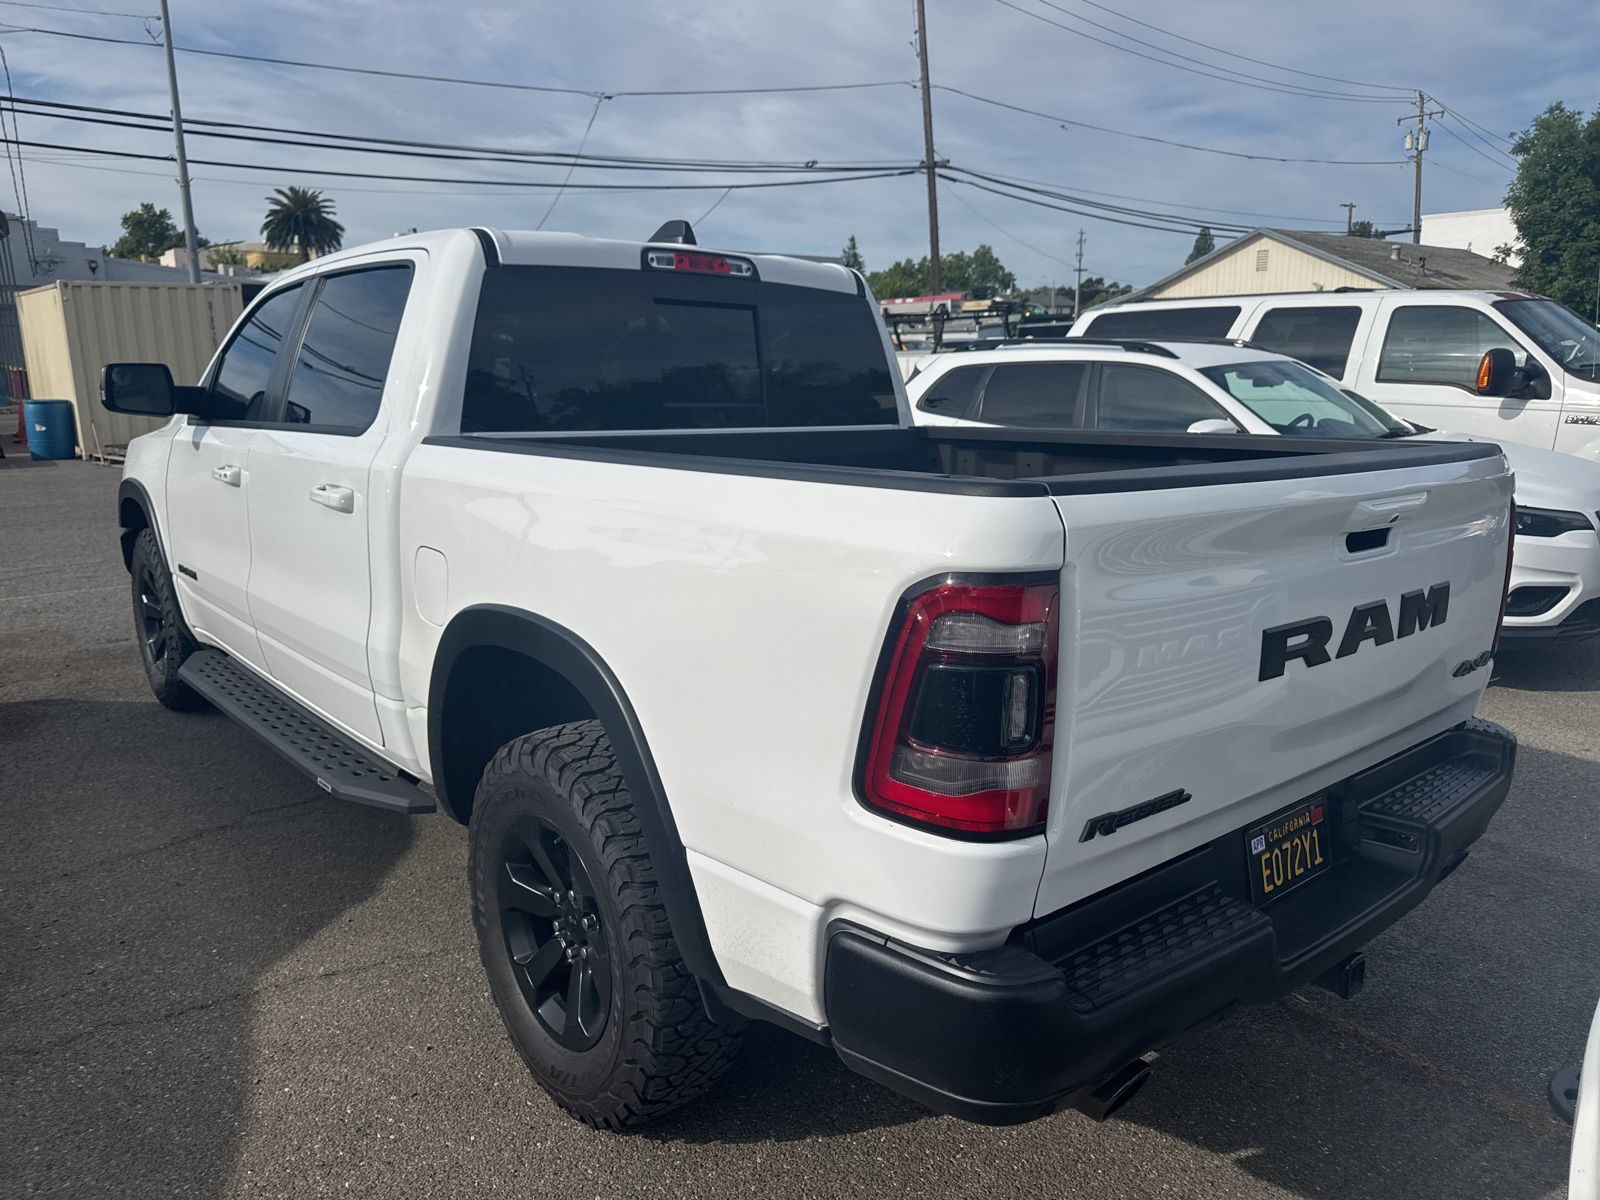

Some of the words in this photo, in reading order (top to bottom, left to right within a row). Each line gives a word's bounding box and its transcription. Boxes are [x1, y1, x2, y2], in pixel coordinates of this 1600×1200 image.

[1258, 581, 1450, 682] RAM
[1268, 811, 1311, 842] CALIFORNIA
[1261, 829, 1323, 893] E072Y1
